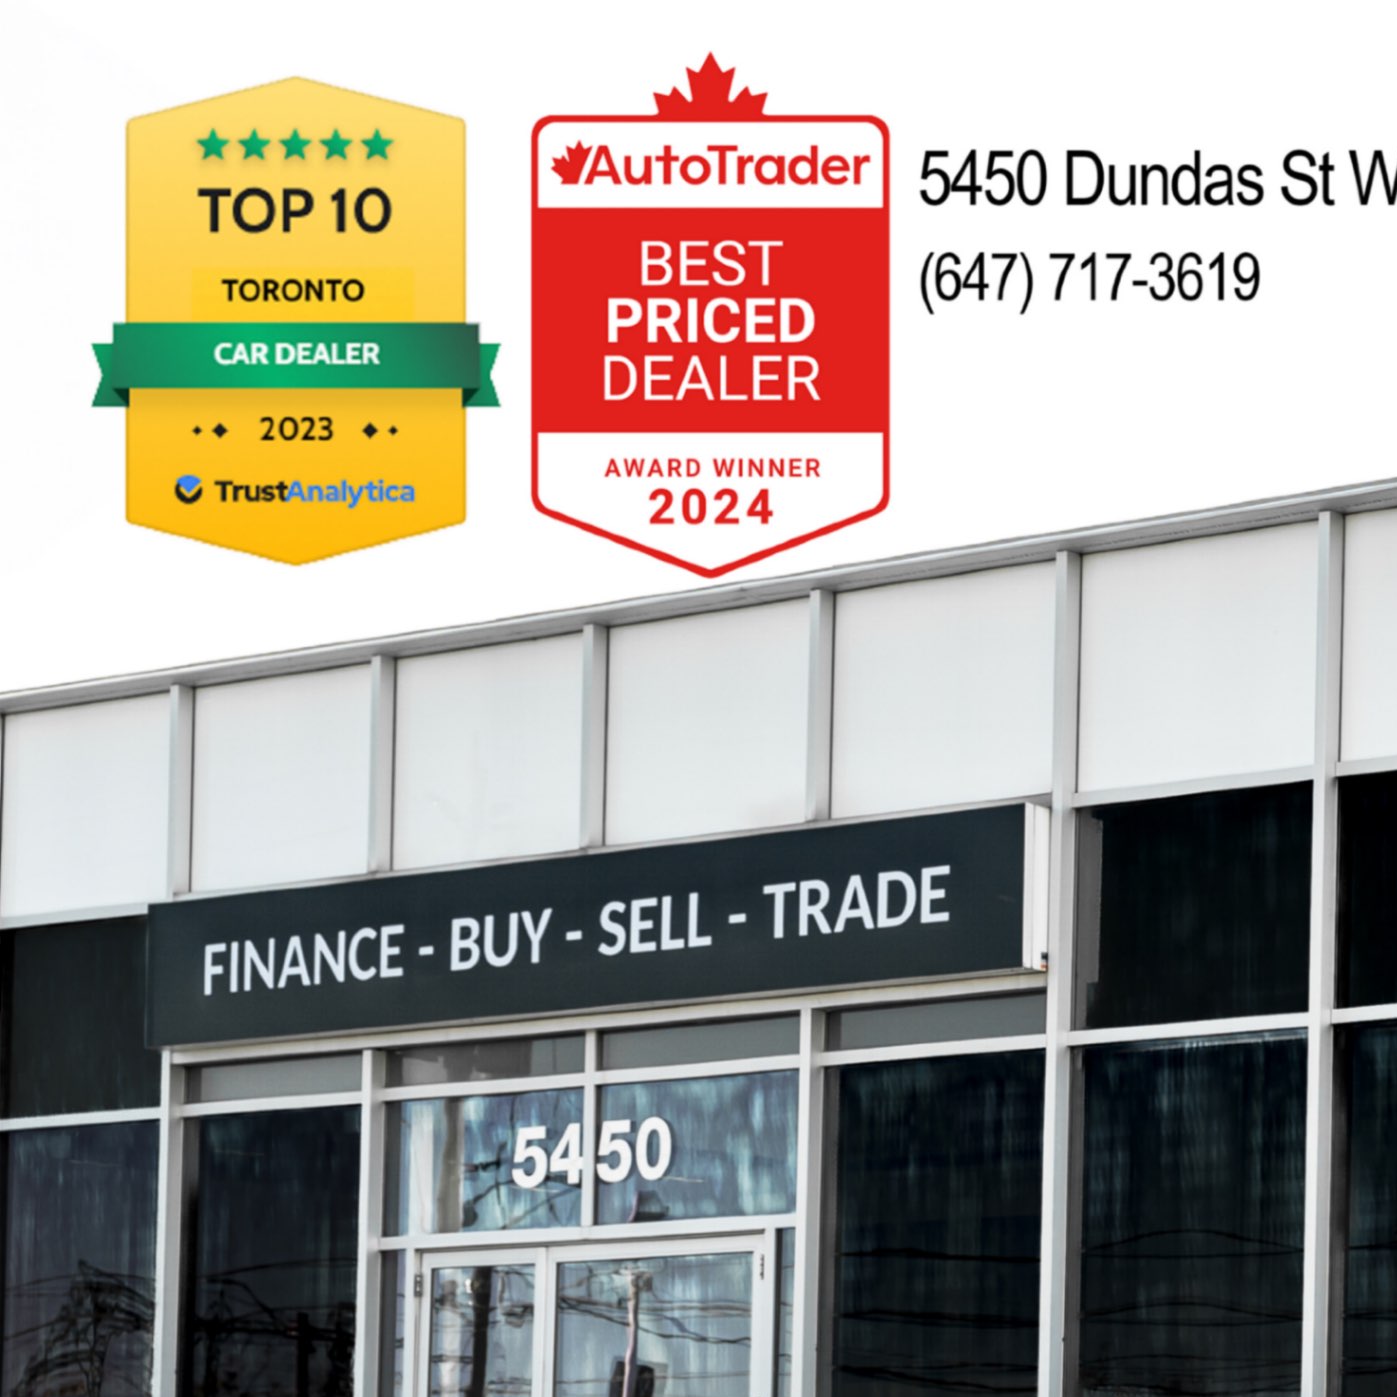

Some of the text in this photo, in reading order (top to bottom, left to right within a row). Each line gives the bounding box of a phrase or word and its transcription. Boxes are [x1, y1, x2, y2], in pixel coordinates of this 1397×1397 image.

[202, 924, 404, 996] FINANCE
[450, 908, 553, 971] BUY
[598, 892, 712, 957] SELL
[764, 865, 951, 940] TRADE
[511, 1116, 672, 1188] 5450
